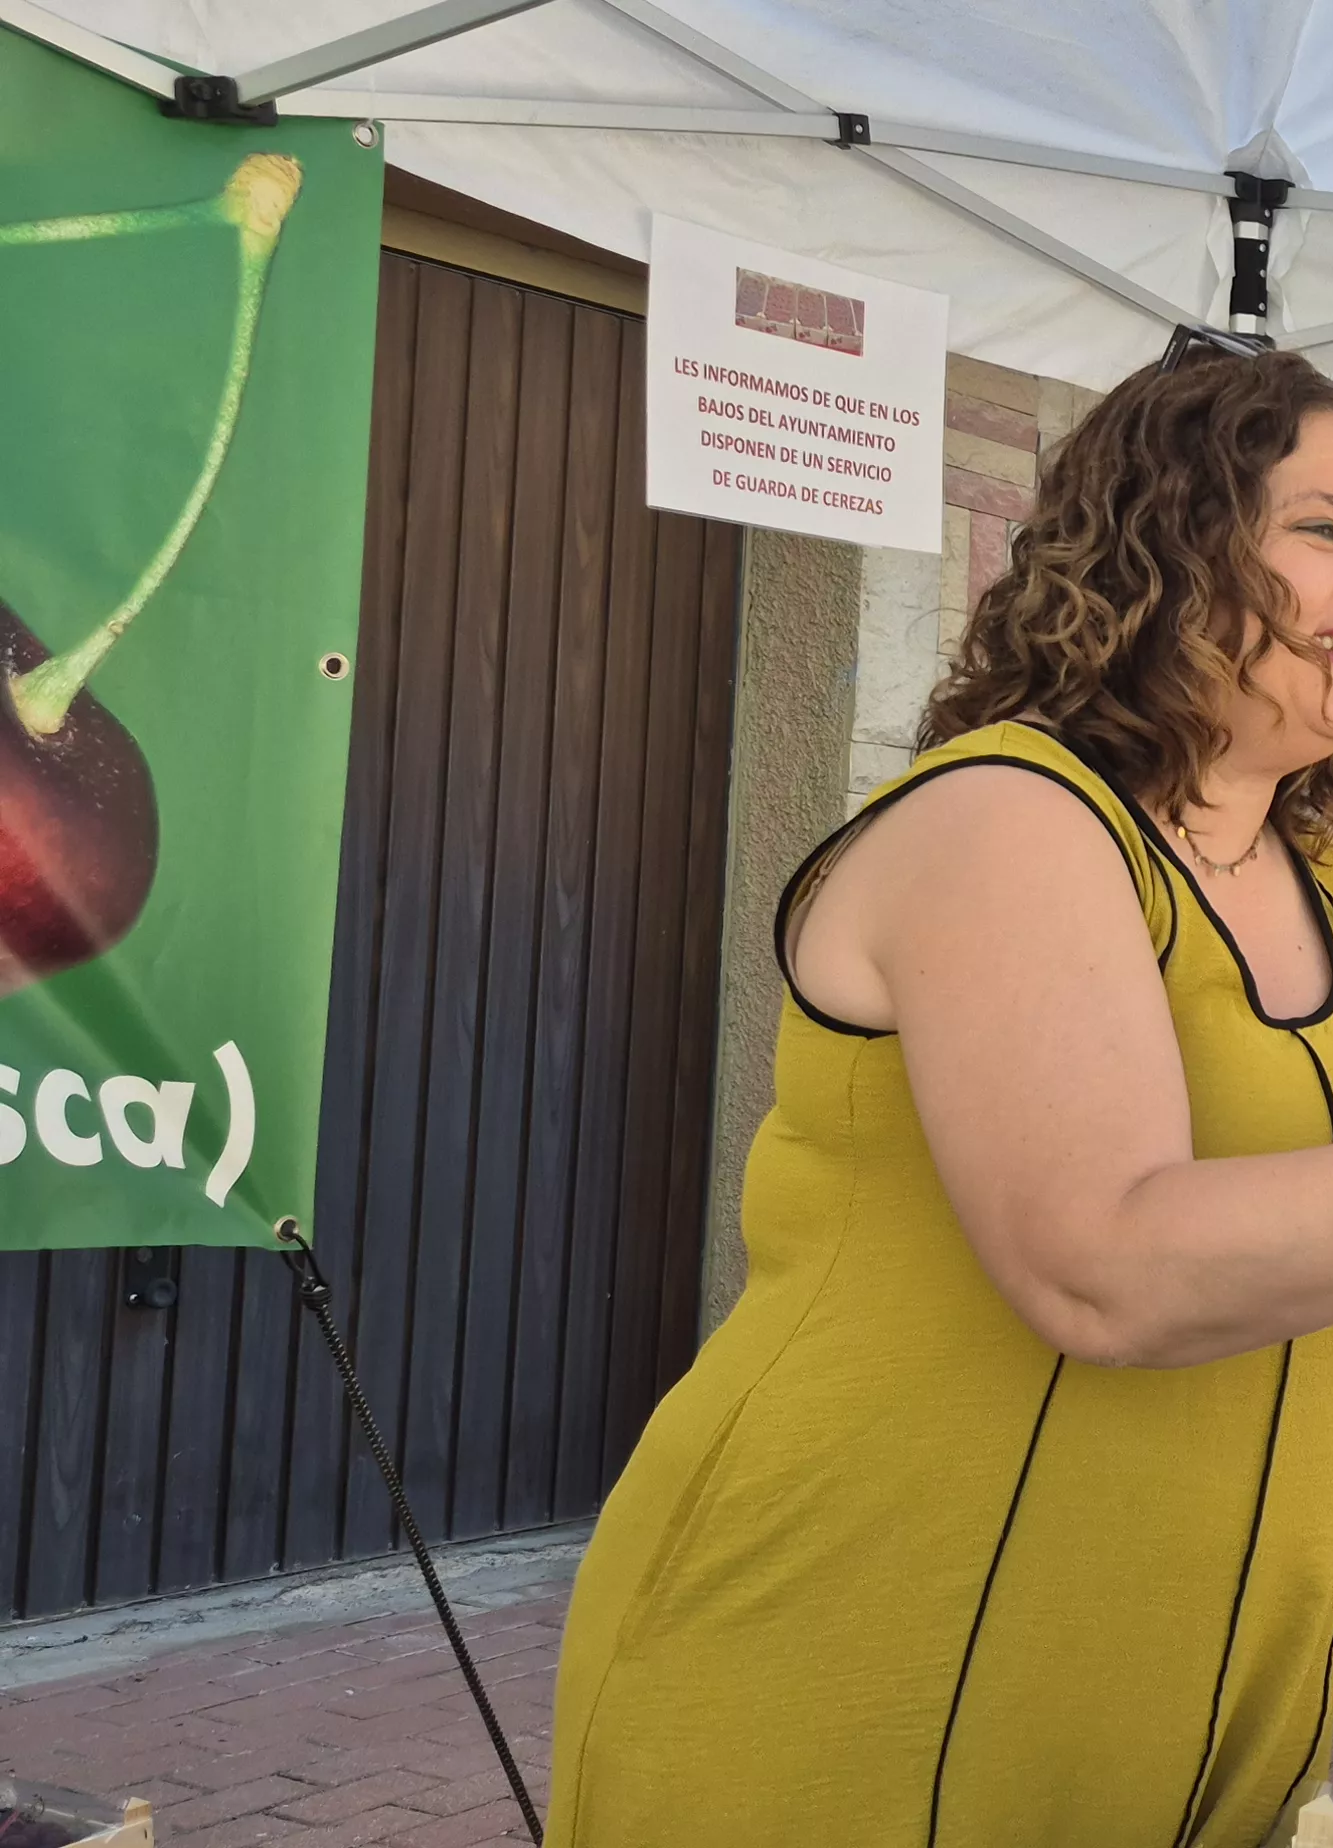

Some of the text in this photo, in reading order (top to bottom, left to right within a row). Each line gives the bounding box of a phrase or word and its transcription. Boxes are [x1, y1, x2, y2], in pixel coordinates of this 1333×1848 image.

[674, 356, 920, 426] LES INFORMAMOS DE QUE EN LOS
[698, 396, 895, 452] BAJOS DEL AYUNTAMIENTO
[701, 431, 892, 482] DISPONEN DE UN SERVICIO
[712, 469, 883, 515] DE GUARDA DE CEREZAS
